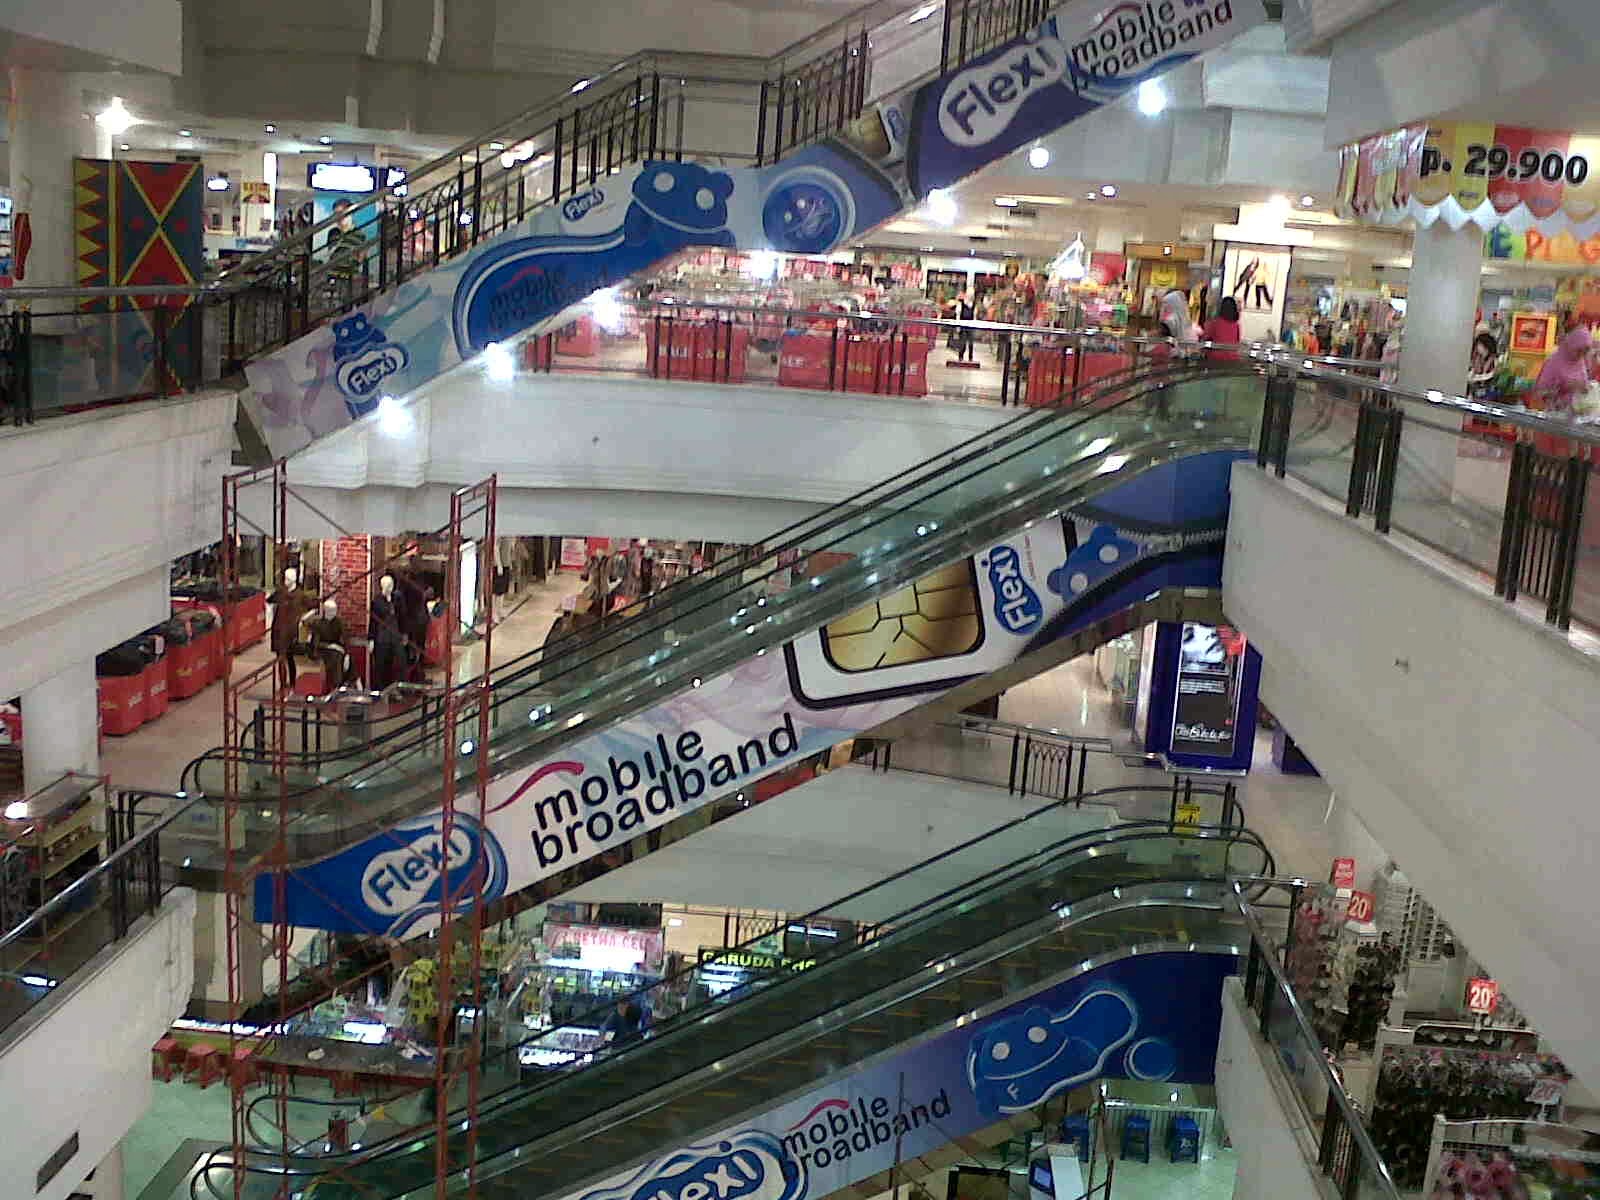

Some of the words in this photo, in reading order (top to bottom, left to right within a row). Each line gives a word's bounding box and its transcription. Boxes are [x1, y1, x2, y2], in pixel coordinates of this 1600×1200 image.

[1072, 0, 1176, 64] mobile
[946, 31, 1057, 136] Flexi
[1465, 143, 1588, 184] 29.900
[349, 352, 397, 394] Flexi
[981, 549, 1037, 631] Flexi
[531, 711, 799, 869] broadband
[533, 731, 704, 831] mobile
[368, 837, 463, 907] Flexi
[781, 1096, 889, 1158] mobile
